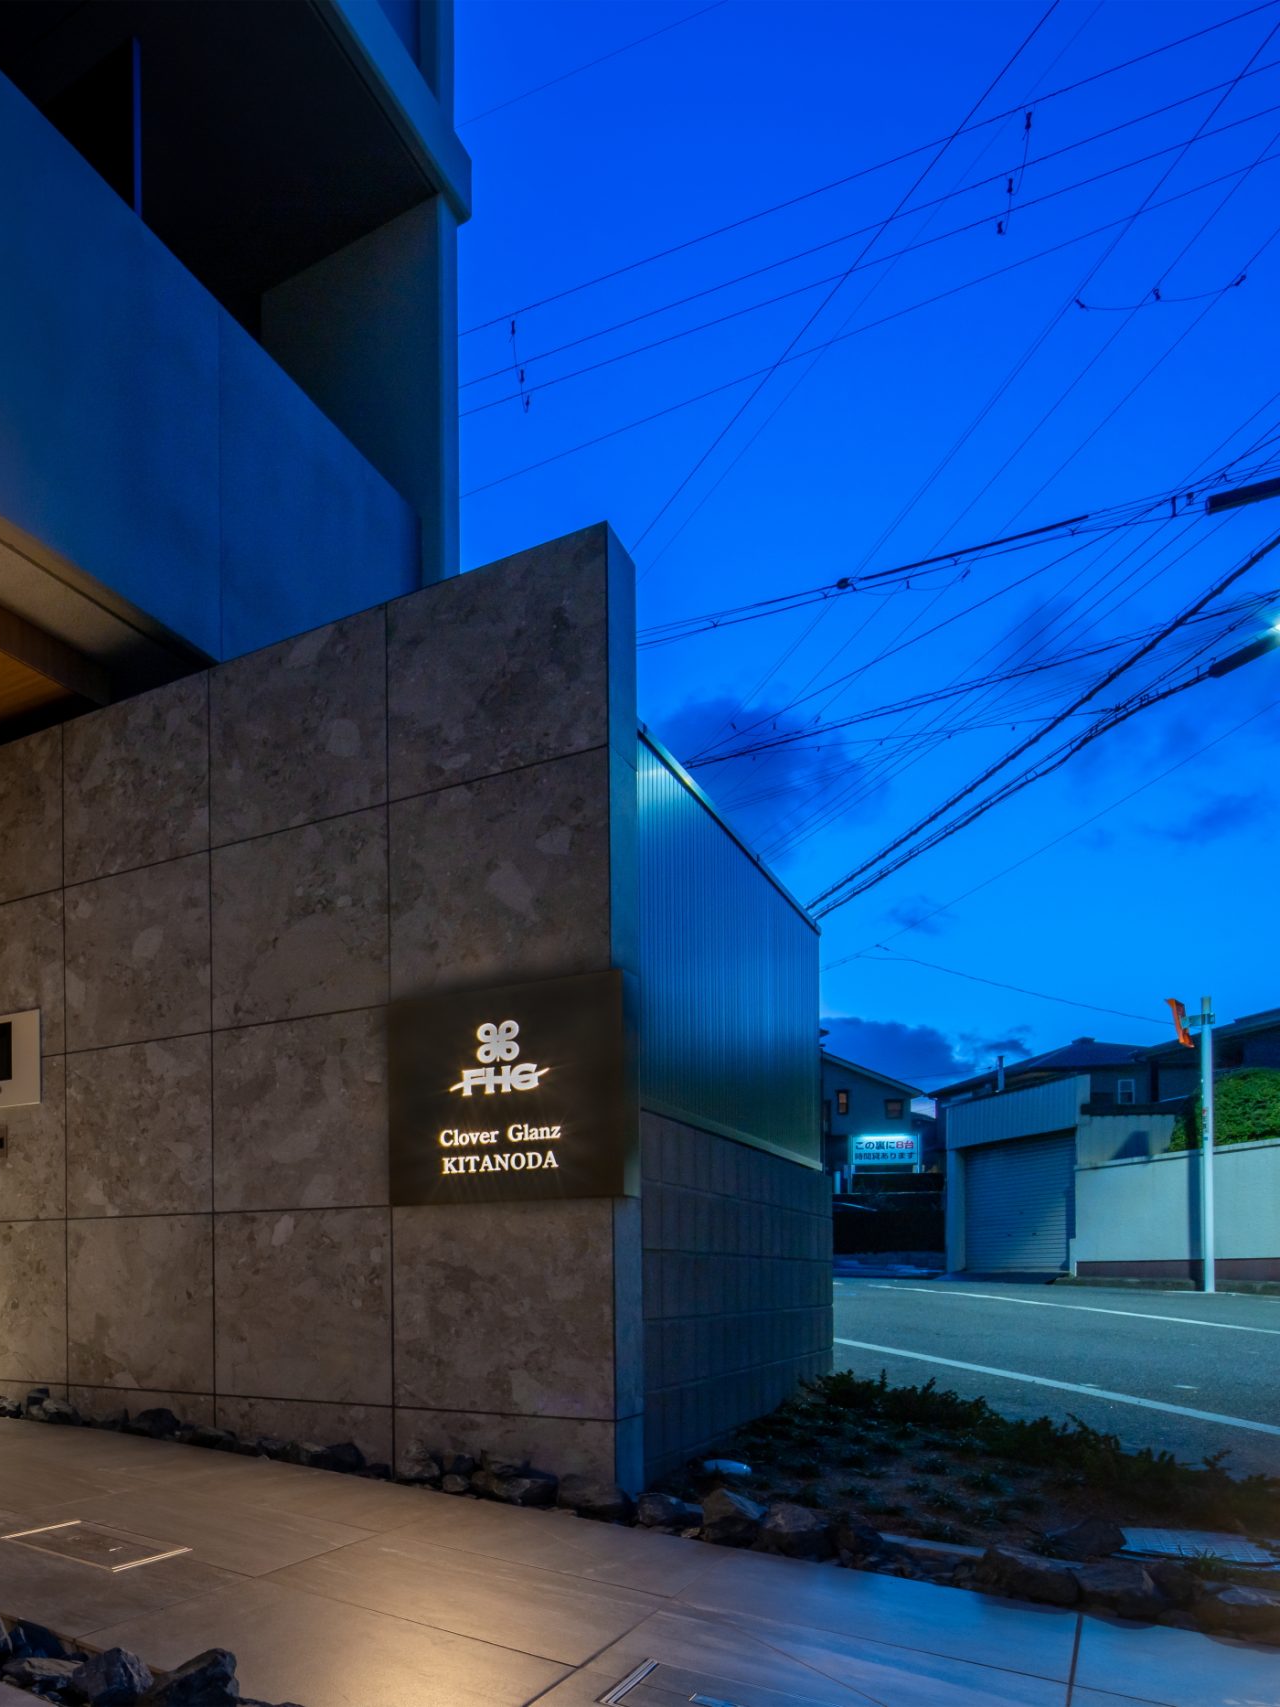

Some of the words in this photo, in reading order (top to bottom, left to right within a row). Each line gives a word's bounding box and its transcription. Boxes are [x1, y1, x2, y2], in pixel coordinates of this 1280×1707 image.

[461, 1062, 540, 1097] FHG
[439, 1128, 499, 1147] Clover
[507, 1123, 562, 1143] Glanz
[441, 1150, 559, 1175] KITANODA
